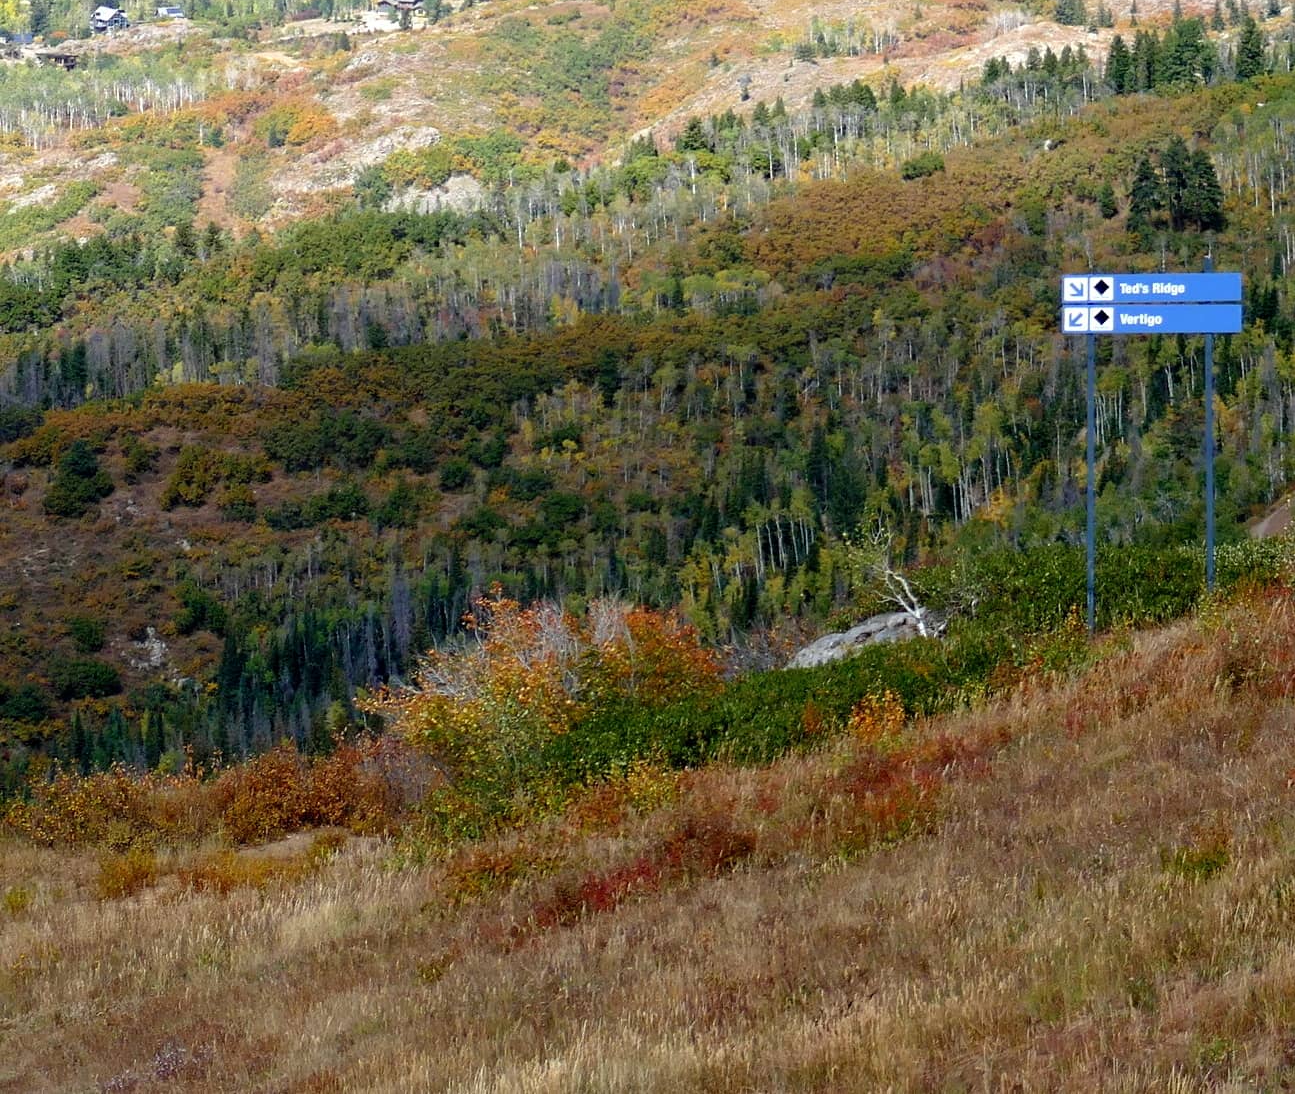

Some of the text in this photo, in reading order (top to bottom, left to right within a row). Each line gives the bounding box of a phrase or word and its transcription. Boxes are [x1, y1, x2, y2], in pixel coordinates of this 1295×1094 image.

[1120, 282, 1185, 296] Ted's Ridge
[1120, 313, 1162, 327] Vertigo
